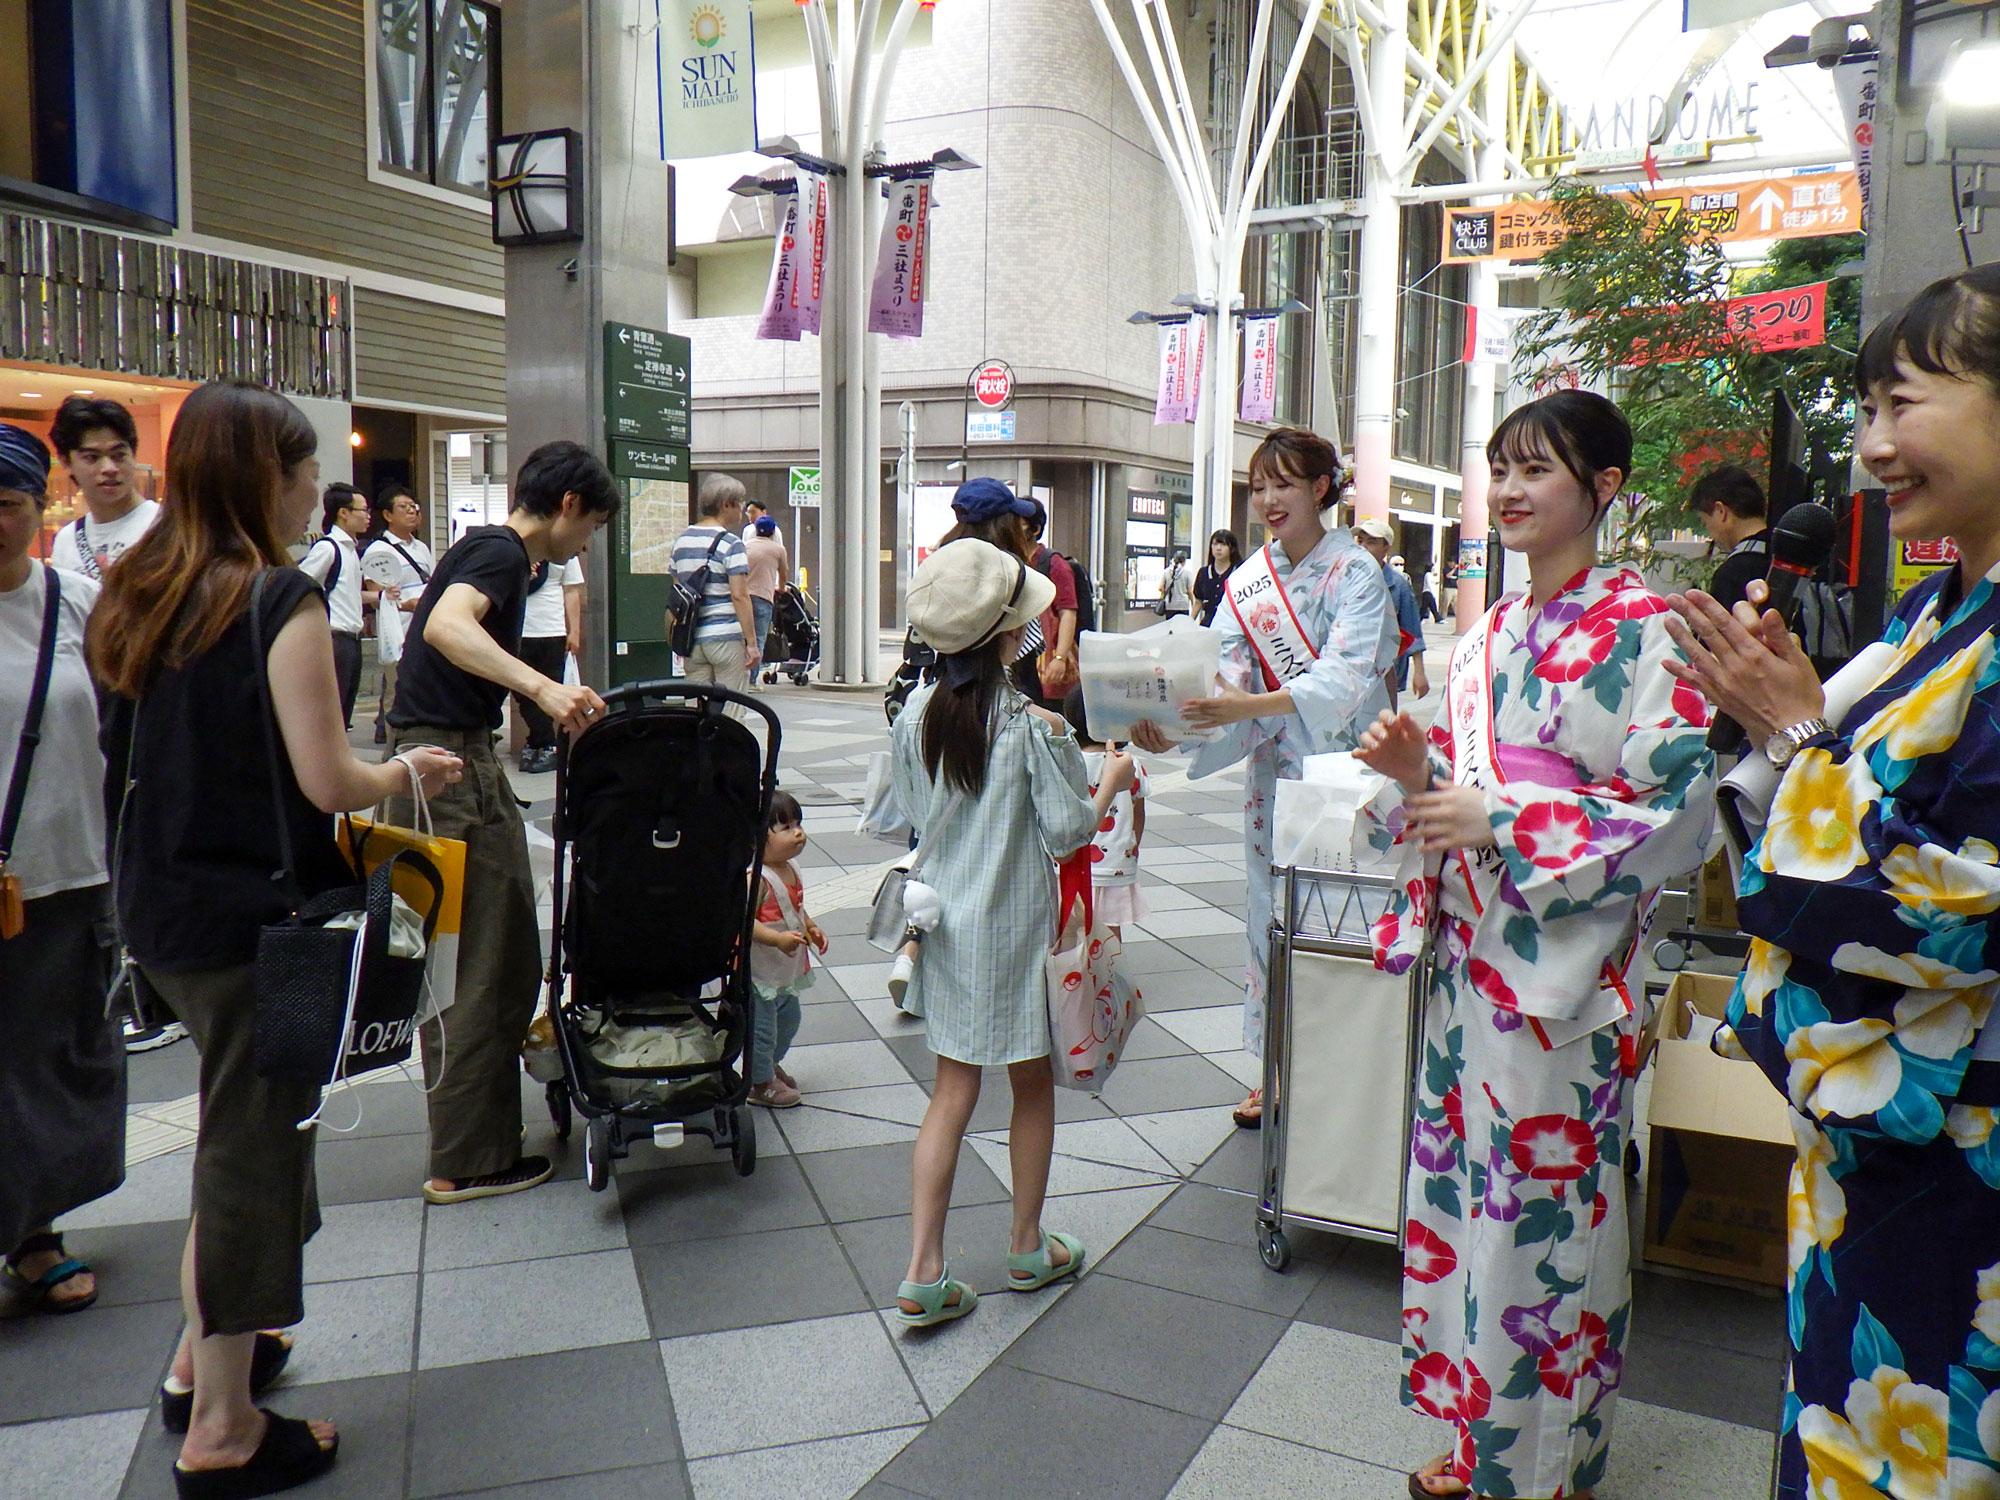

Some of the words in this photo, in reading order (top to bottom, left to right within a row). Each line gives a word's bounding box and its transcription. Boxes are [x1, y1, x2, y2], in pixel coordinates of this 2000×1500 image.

[681, 50, 737, 83] SUN
[682, 93, 739, 109] ICHIBANCHO
[683, 77, 738, 100] MALL
[1858, 68, 1878, 120] 一番町
[898, 184, 915, 223] 一番町
[1690, 192, 1739, 210] 新店舗
[1791, 182, 1842, 209] 直進
[1456, 219, 1488, 236] 快活
[1782, 208, 1849, 228] 徒歩1分
[1456, 237, 1488, 250] CLUB
[893, 244, 909, 307] 三社まつり
[978, 377, 1007, 395] 消火栓
[628, 450, 677, 465] サンモール一番町
[1233, 575, 1272, 605] 2025
[1451, 633, 1484, 682] 2025
[1460, 729, 1485, 791] ミス
[345, 1018, 412, 1056] LOEW
